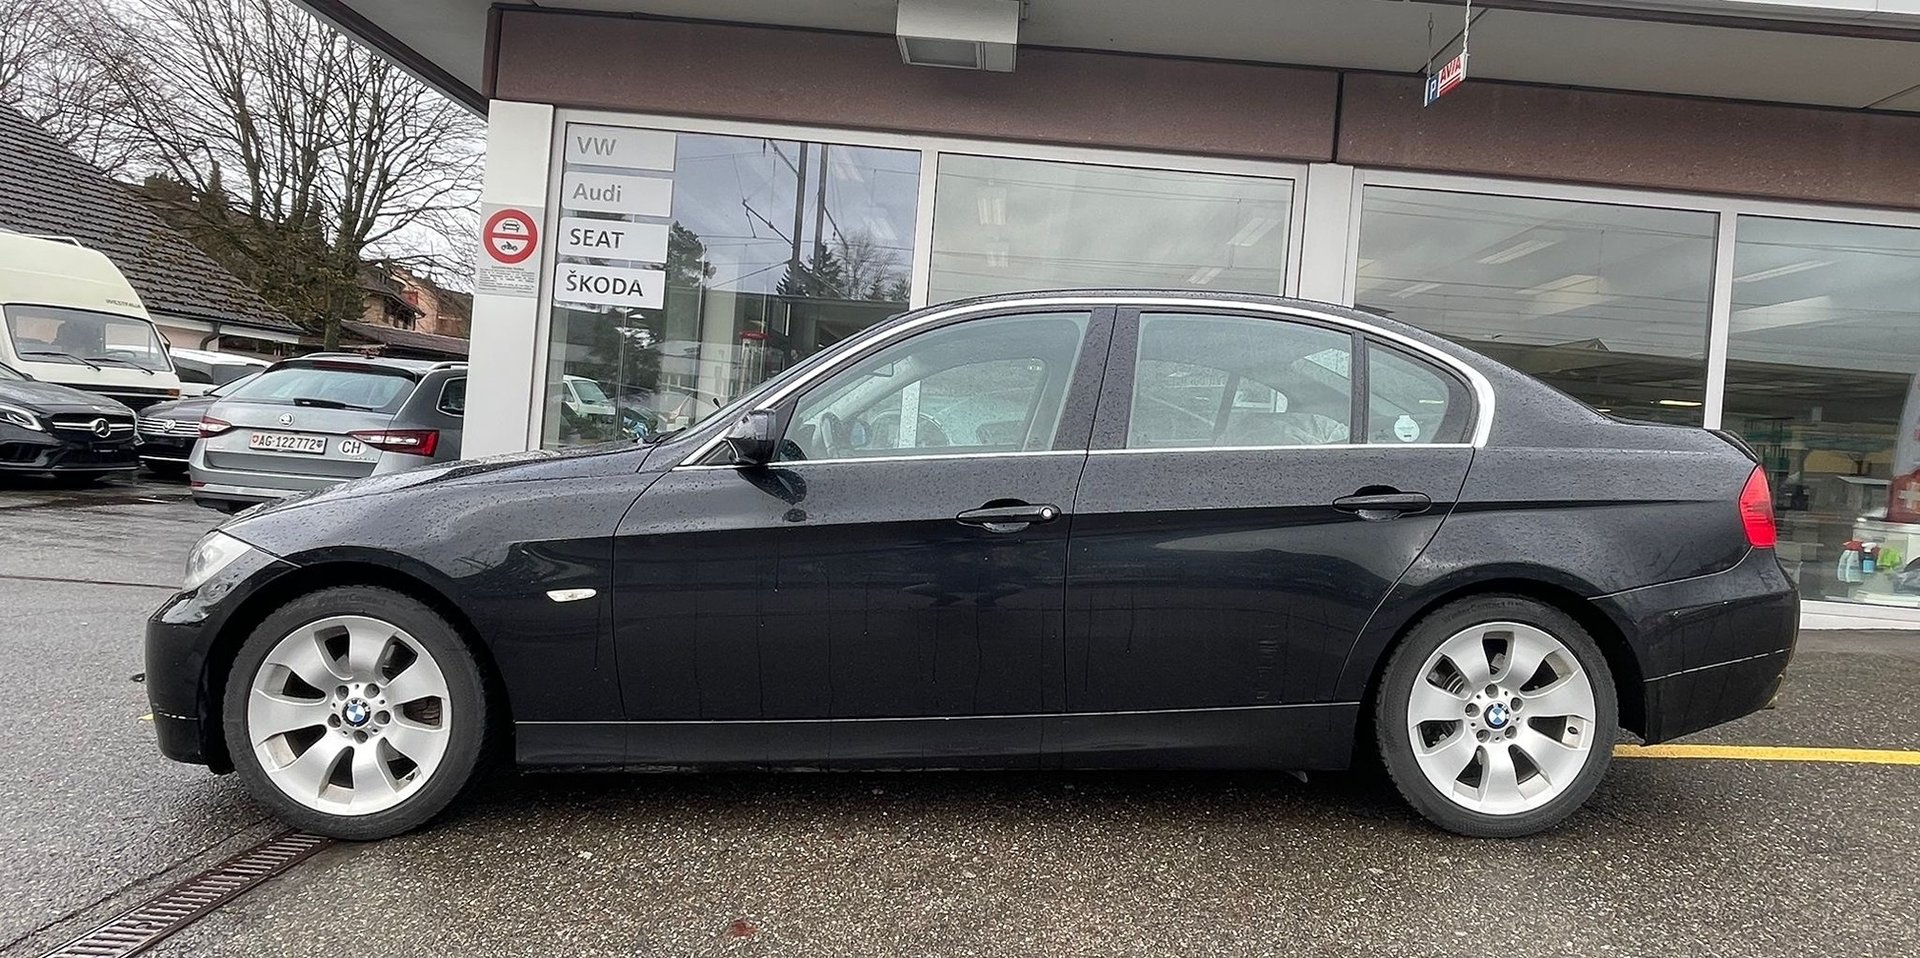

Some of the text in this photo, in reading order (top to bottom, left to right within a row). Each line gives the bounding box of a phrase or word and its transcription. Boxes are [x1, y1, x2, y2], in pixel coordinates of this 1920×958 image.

[1440, 56, 1462, 83] AVIA
[1430, 79, 1437, 100] P
[577, 136, 617, 156] VW
[572, 183, 622, 203] Audi
[569, 228, 625, 249] SEAT
[566, 269, 644, 297] ŠKODA
[342, 440, 362, 454] CH
